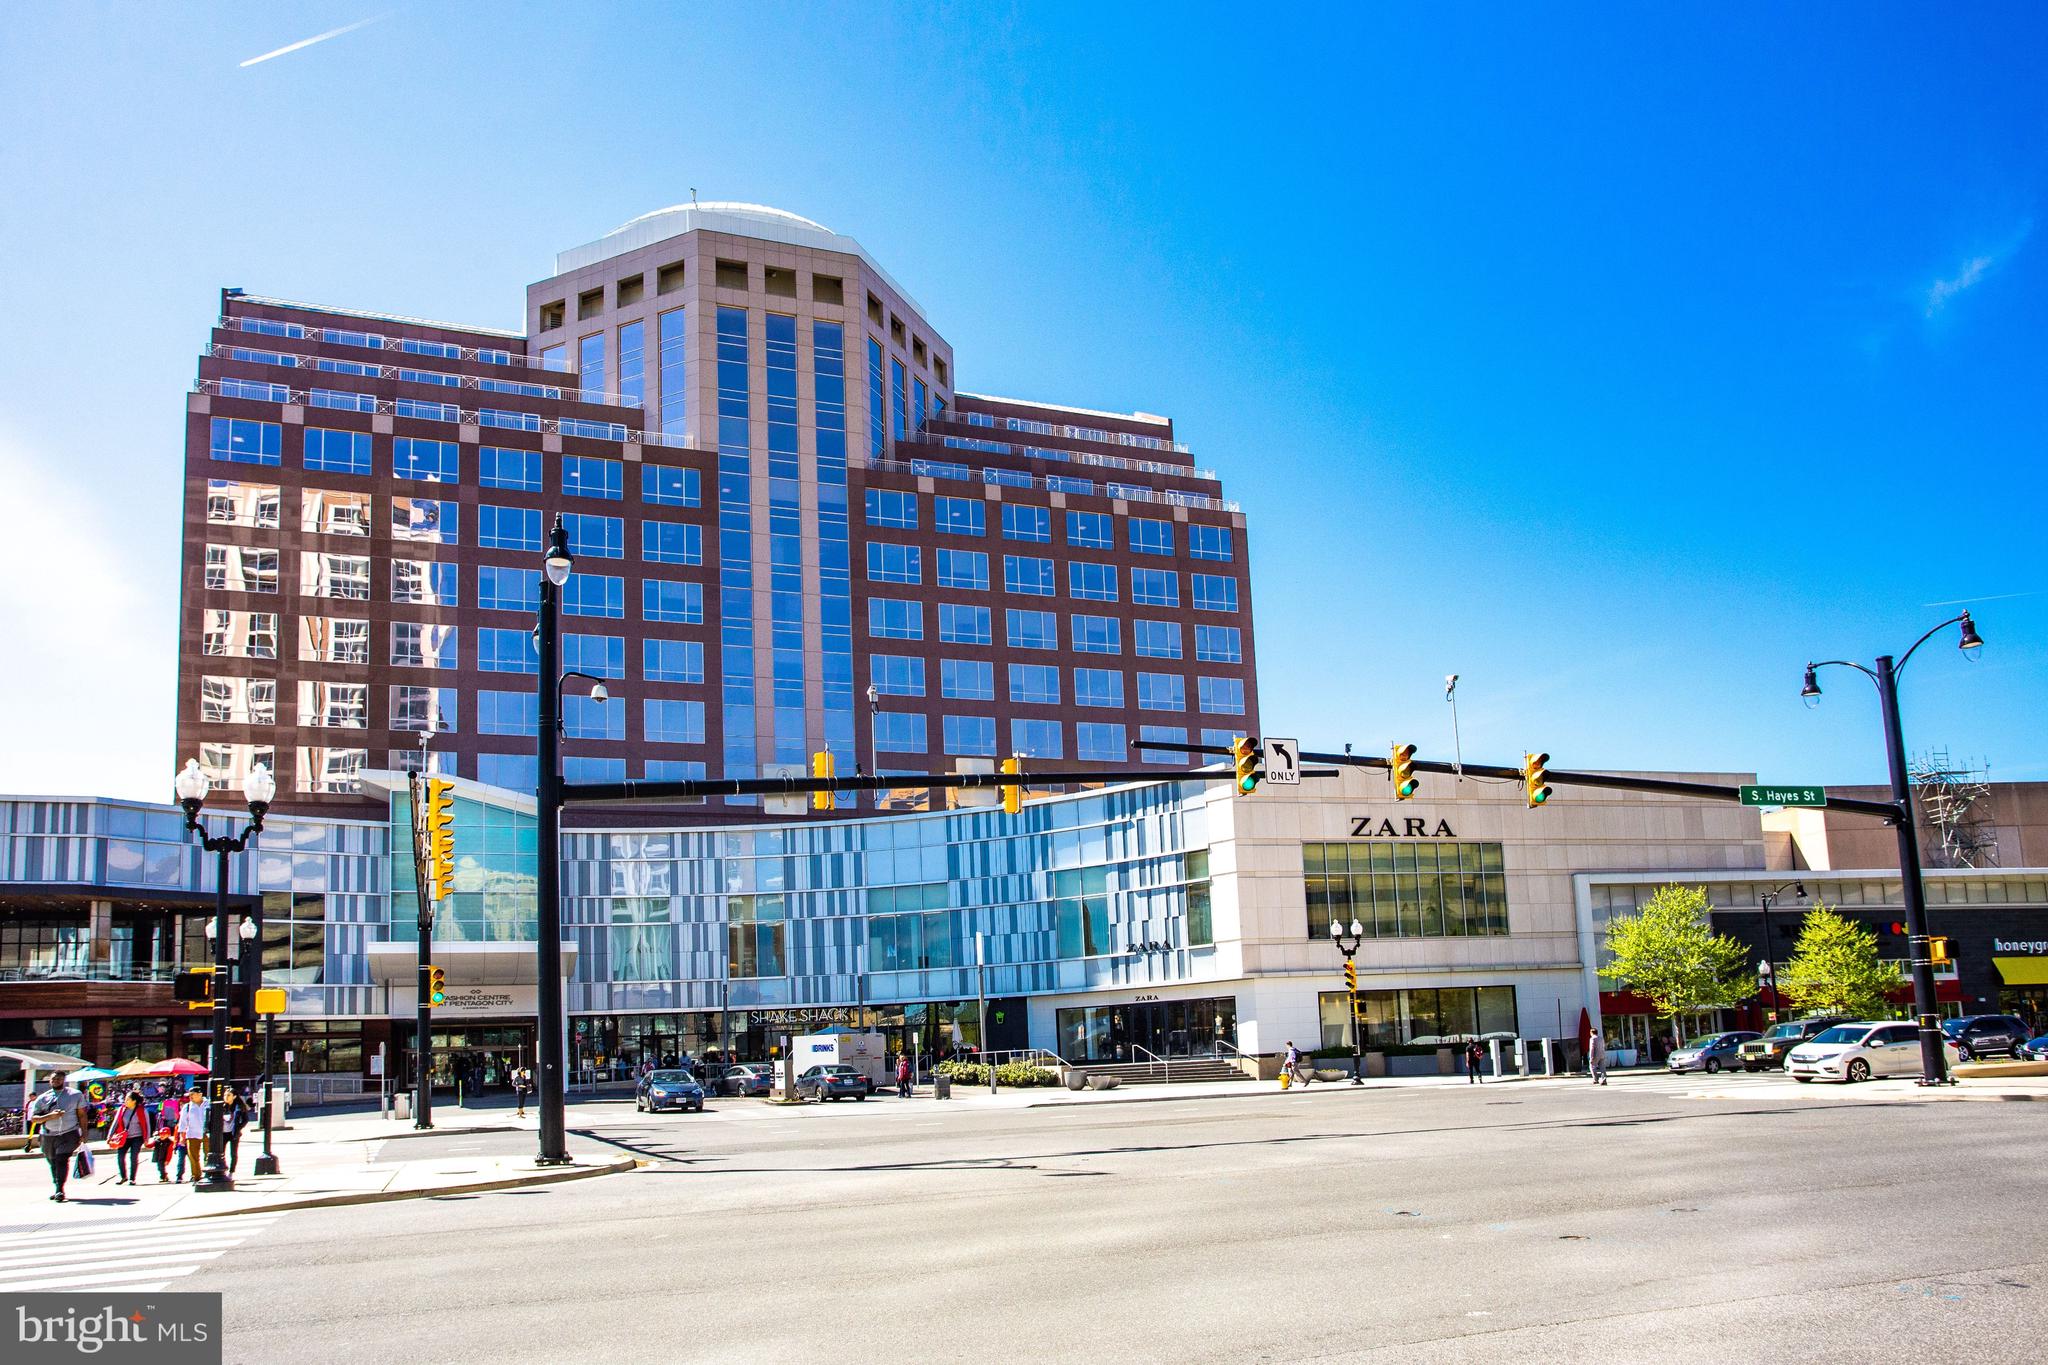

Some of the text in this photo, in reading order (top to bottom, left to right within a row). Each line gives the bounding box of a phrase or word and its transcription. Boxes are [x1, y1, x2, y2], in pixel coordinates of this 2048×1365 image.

[1271, 771, 1295, 781] ONLY
[1751, 790, 1815, 803] S. Hayes St
[1351, 817, 1457, 837] ZARA
[1126, 940, 1174, 953] ZARA
[751, 1007, 849, 1023] SHAKE SHACK
